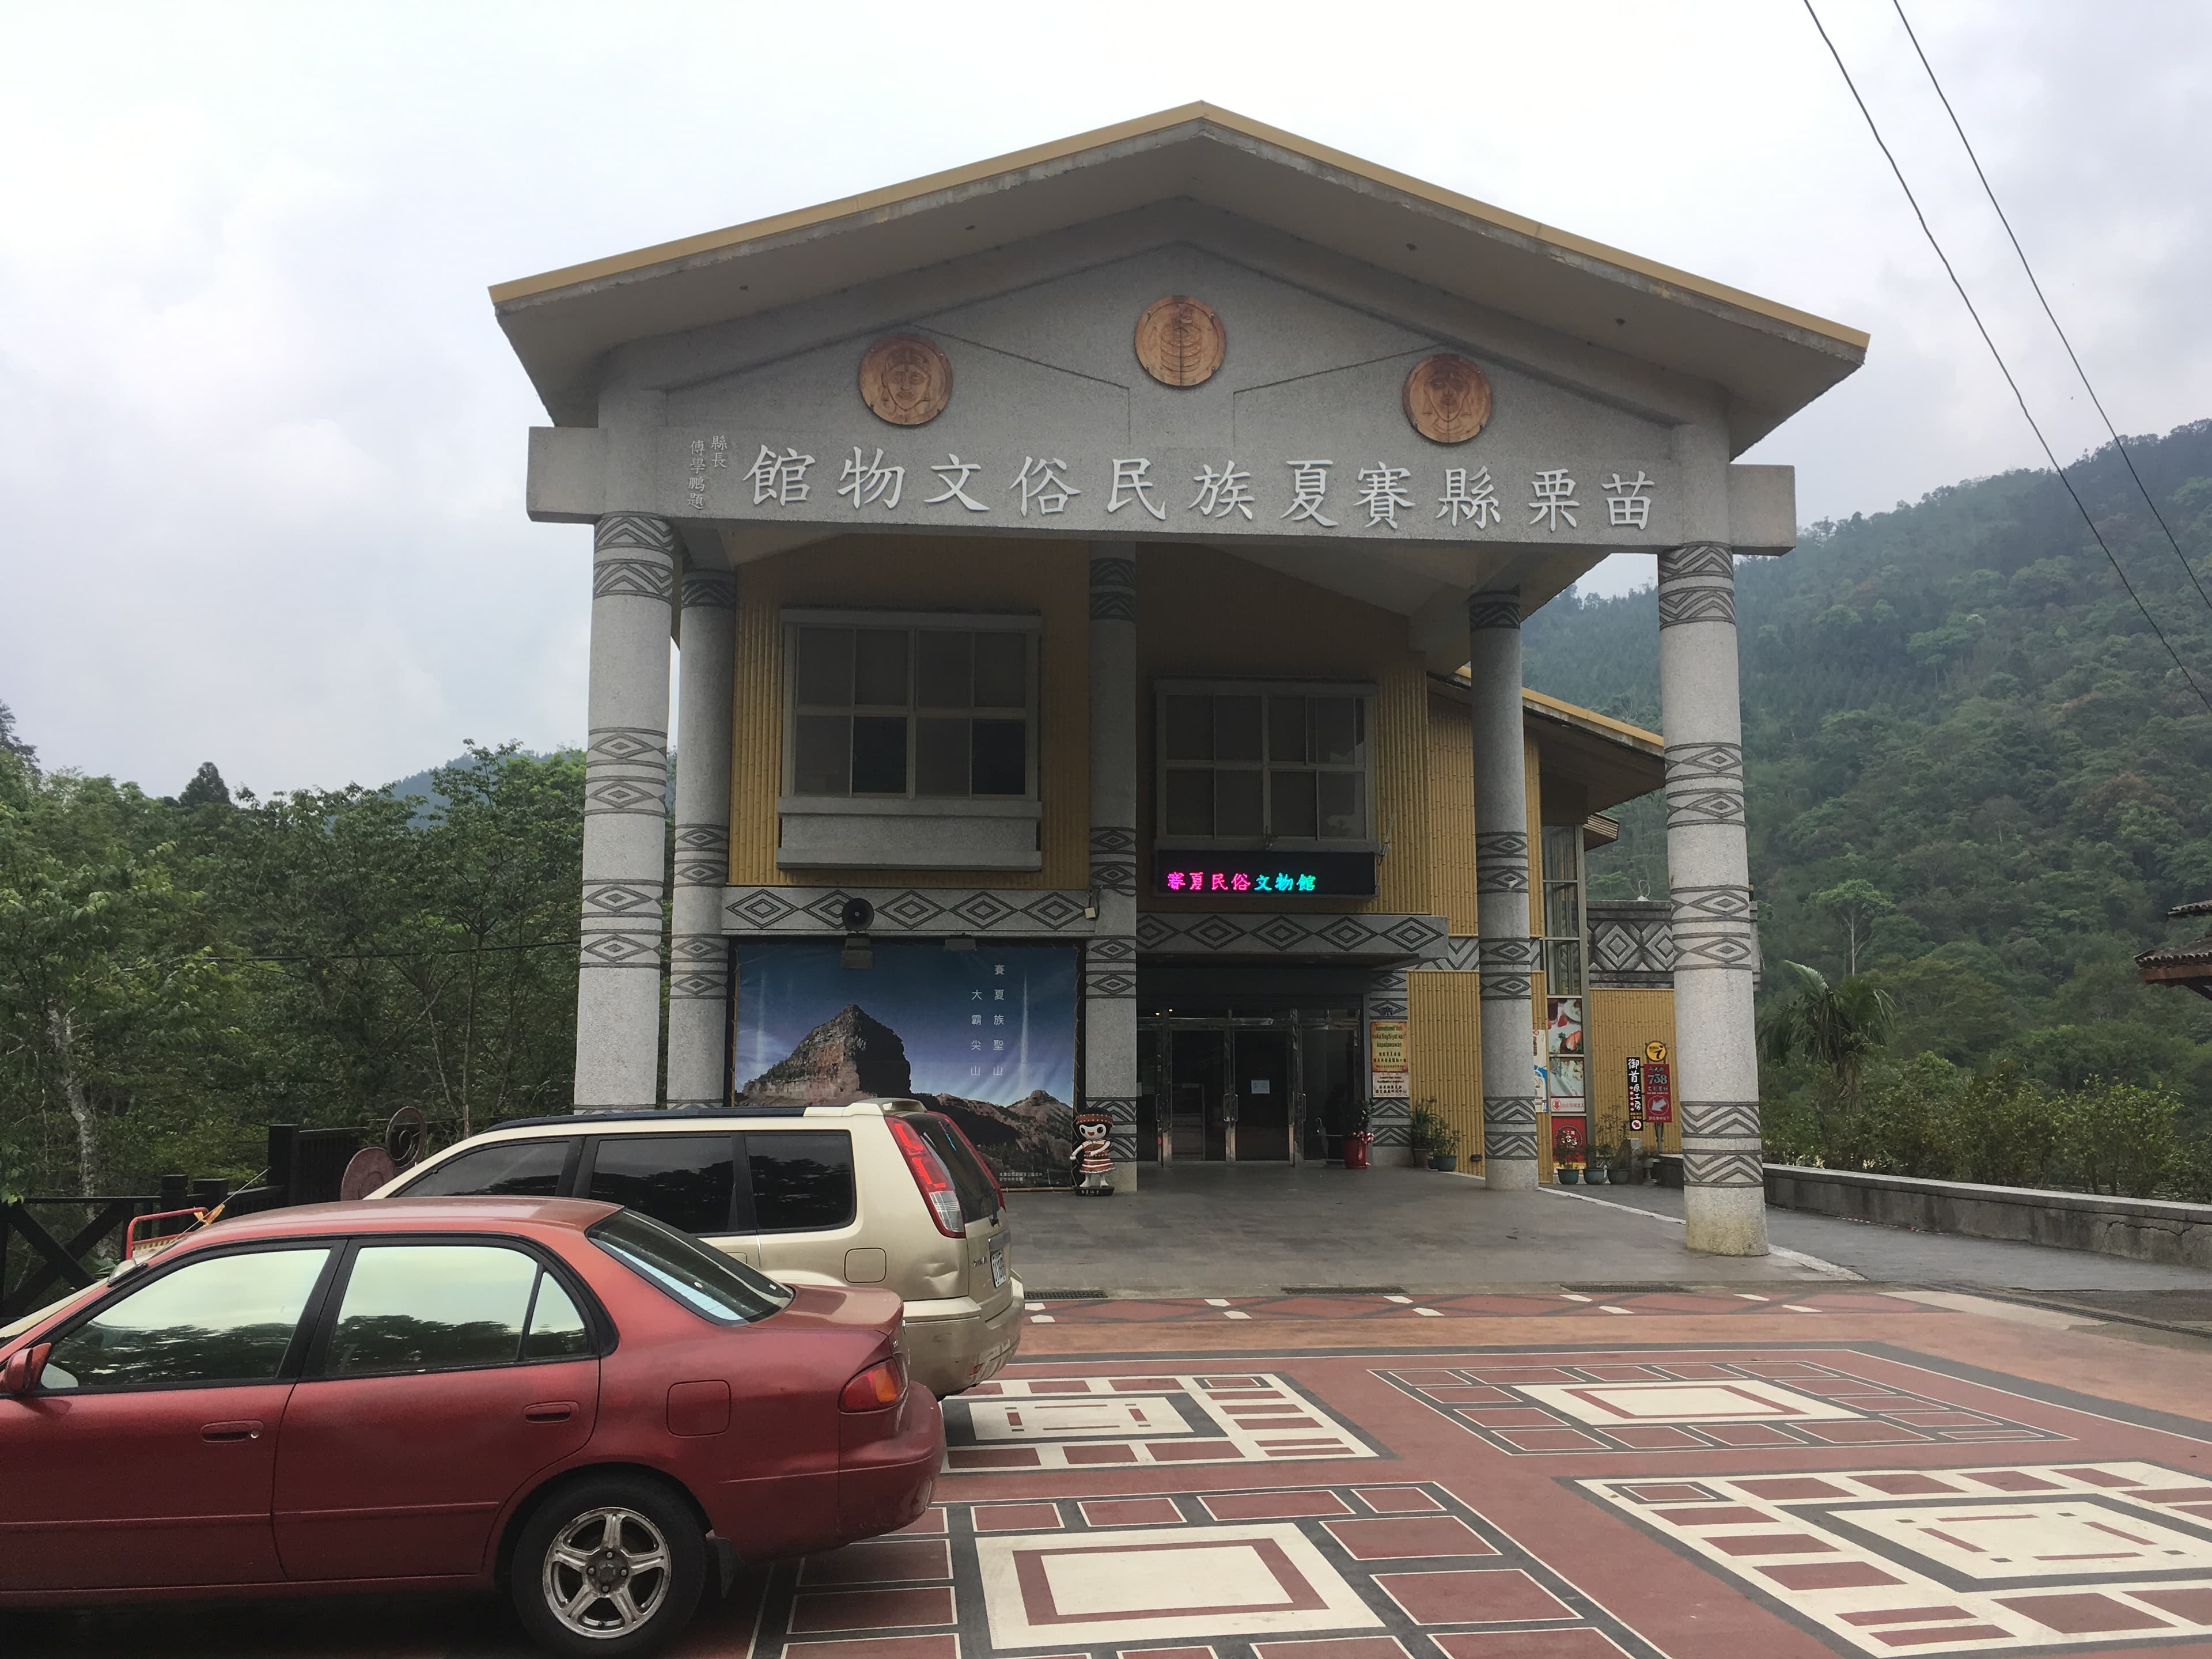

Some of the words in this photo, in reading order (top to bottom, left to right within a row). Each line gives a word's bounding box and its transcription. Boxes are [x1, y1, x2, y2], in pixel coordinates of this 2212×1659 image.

[743, 444, 1656, 531] 苗栗縣賽夏族民俗文物館
[970, 989, 983, 1076] 大霸尖山
[993, 964, 1005, 1076] 賽夏族聖山
[1647, 1073, 1668, 1085] 738
